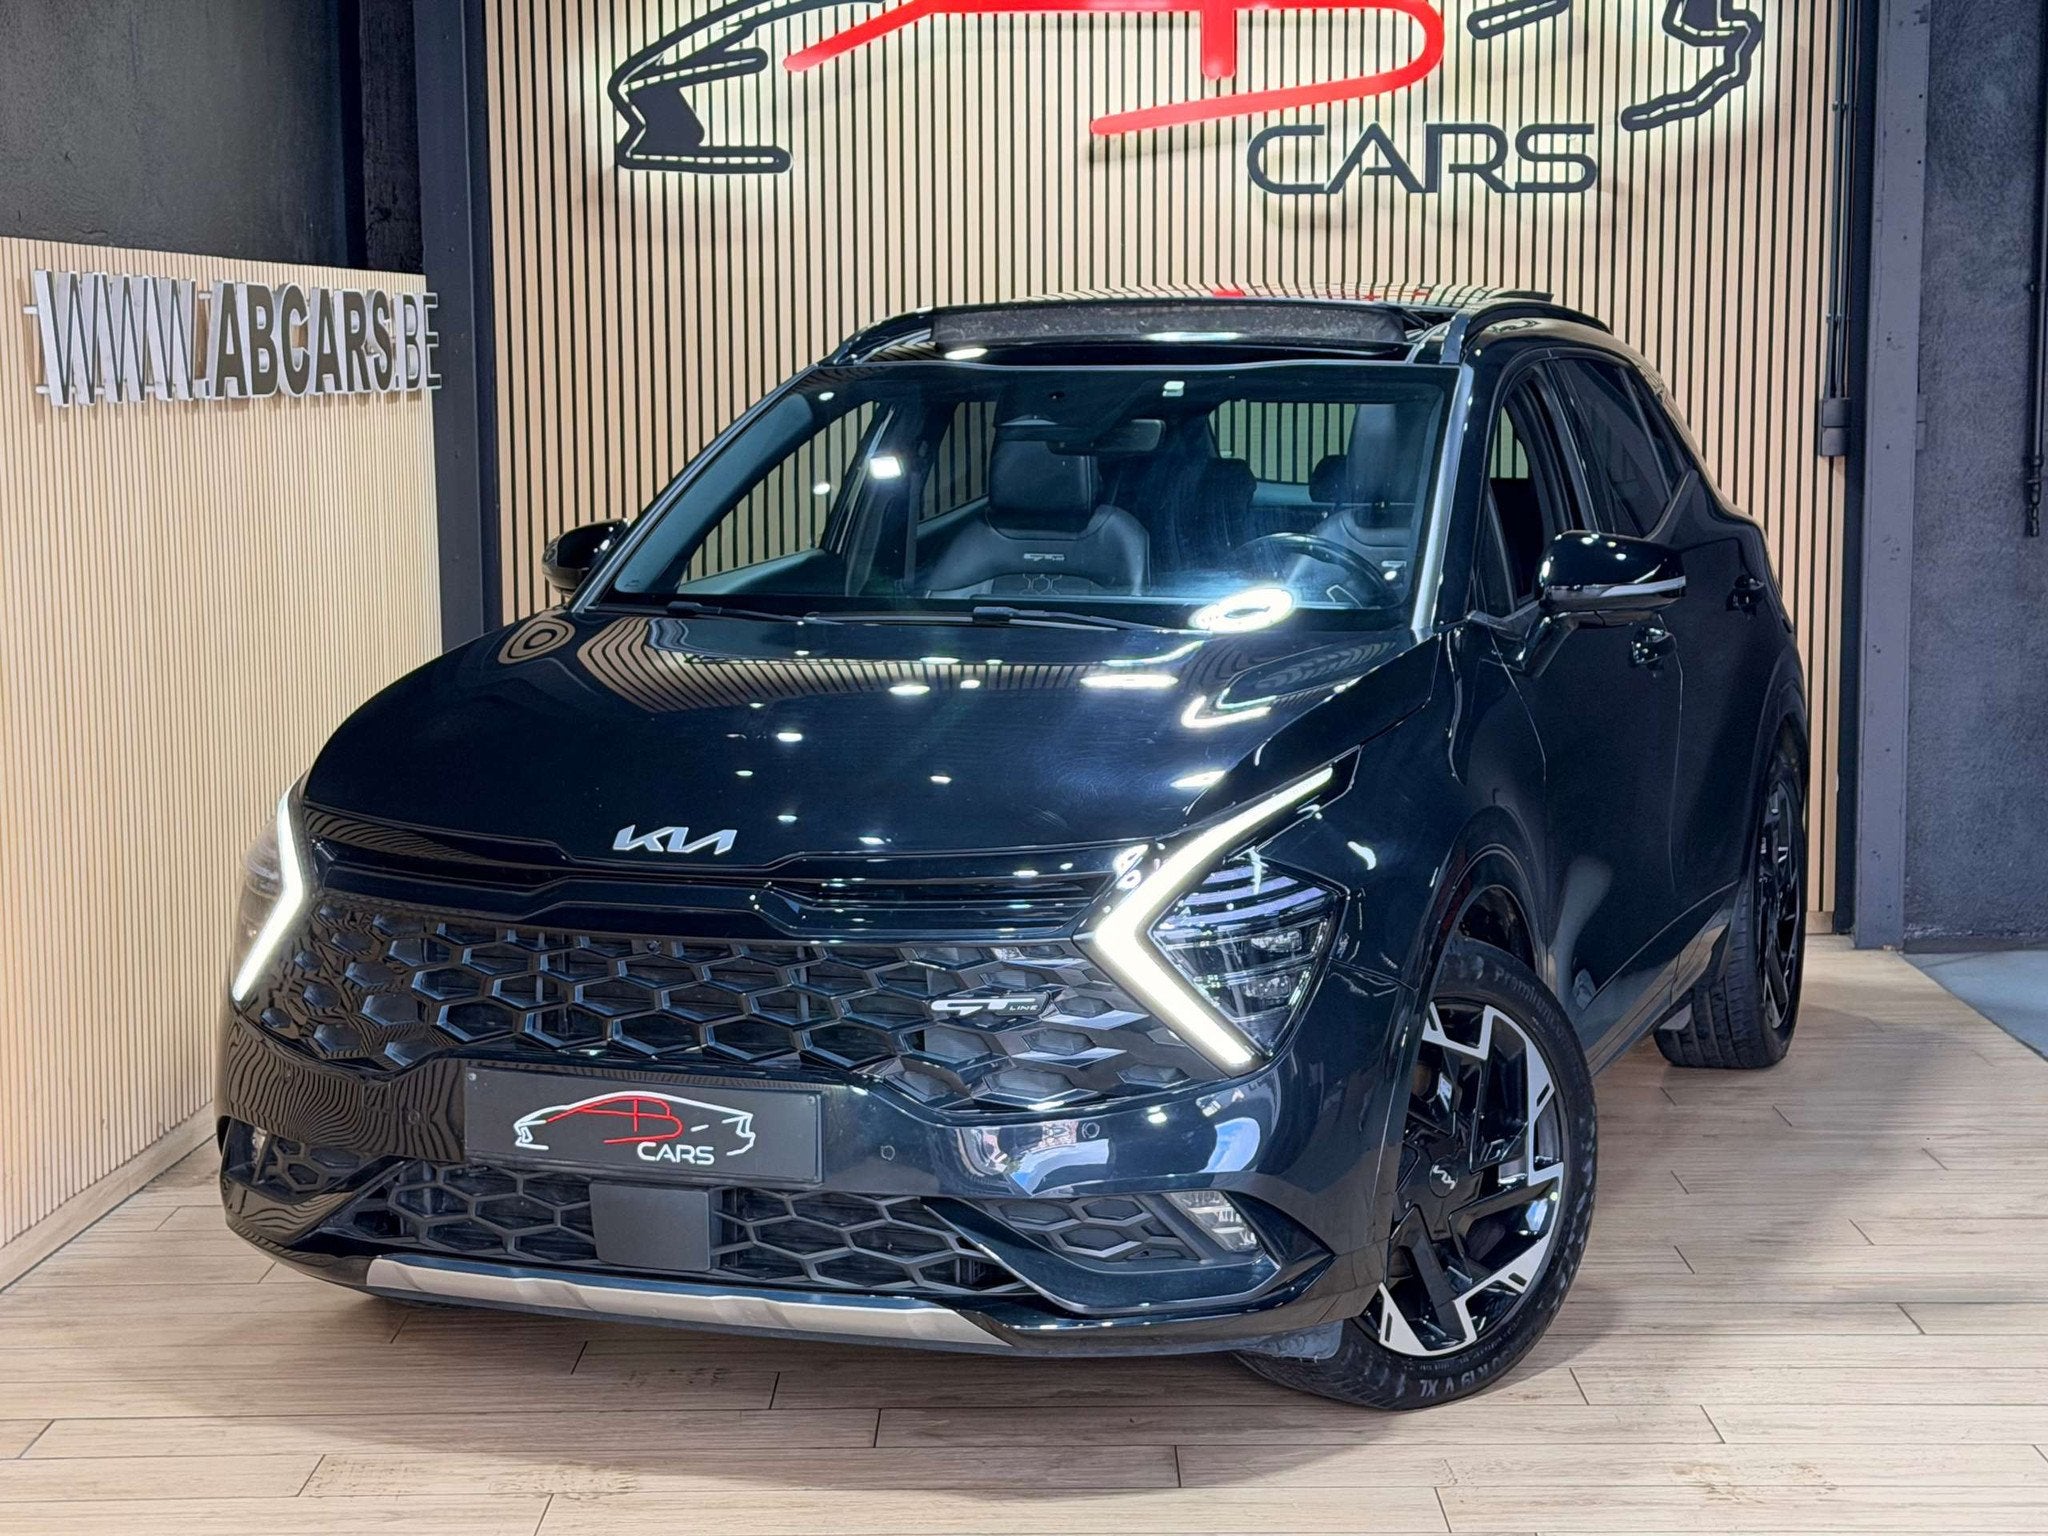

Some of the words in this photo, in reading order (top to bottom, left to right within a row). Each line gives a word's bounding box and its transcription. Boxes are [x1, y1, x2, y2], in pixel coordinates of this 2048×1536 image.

[1246, 121, 1597, 194] CARS
[34, 269, 441, 407] WWW.ABCARS.BE
[612, 824, 738, 855] KIA
[637, 1141, 714, 1166] CARS
